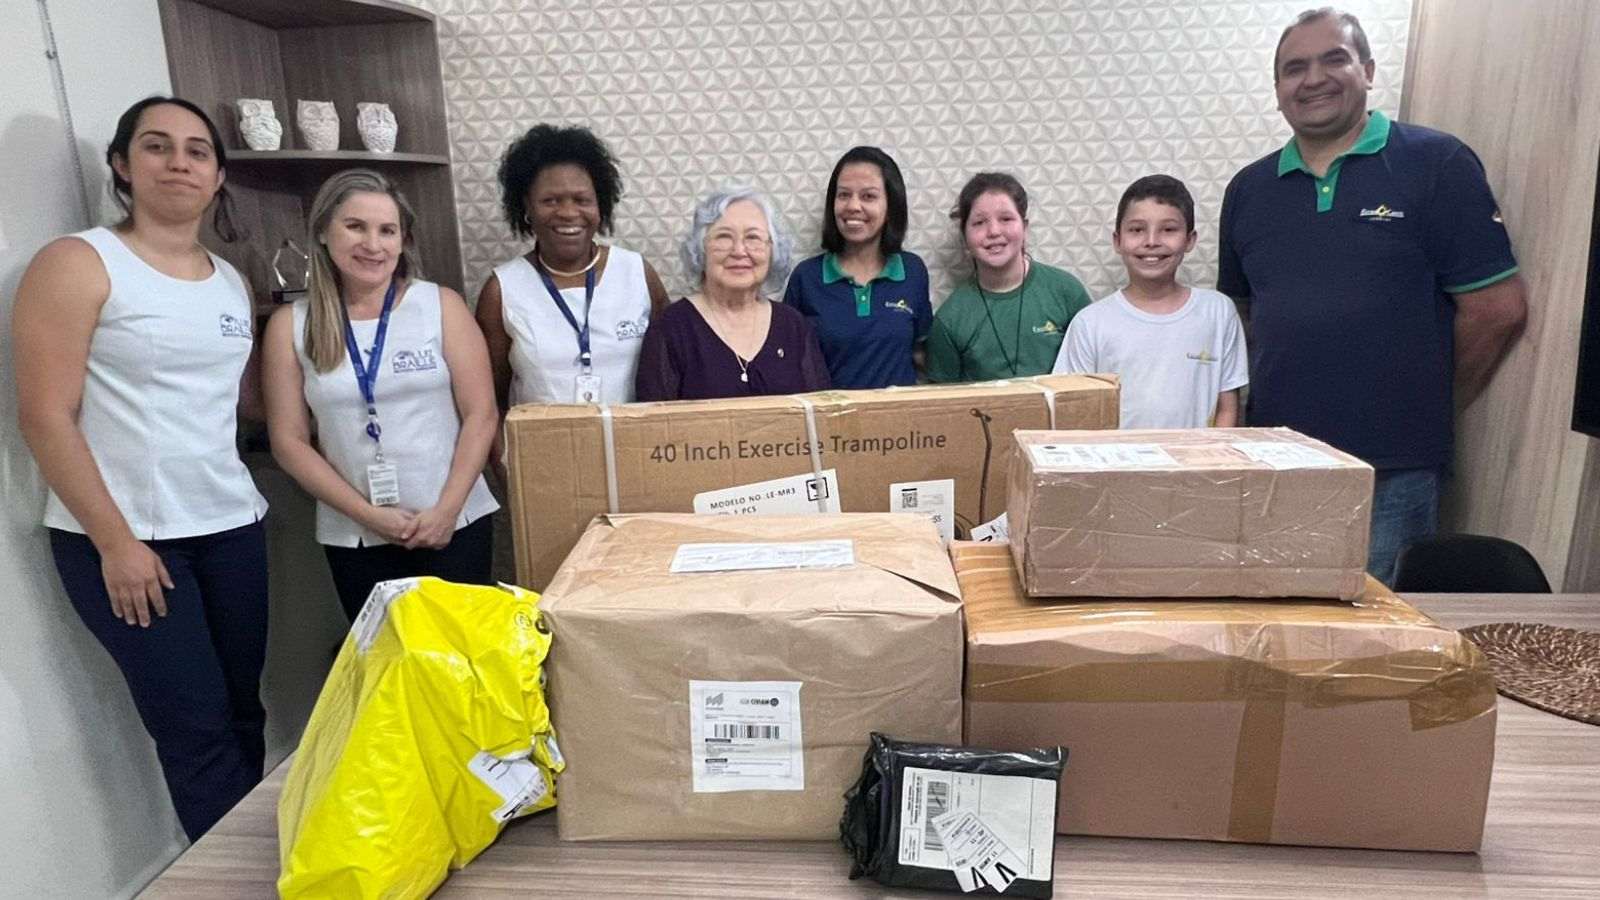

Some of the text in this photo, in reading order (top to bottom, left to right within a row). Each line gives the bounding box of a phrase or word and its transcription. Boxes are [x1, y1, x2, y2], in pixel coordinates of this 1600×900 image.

[650, 430, 947, 463] 40 Inch Exercise Trampoline
[710, 497, 746, 509] MODELO
[742, 506, 757, 514] PCS
